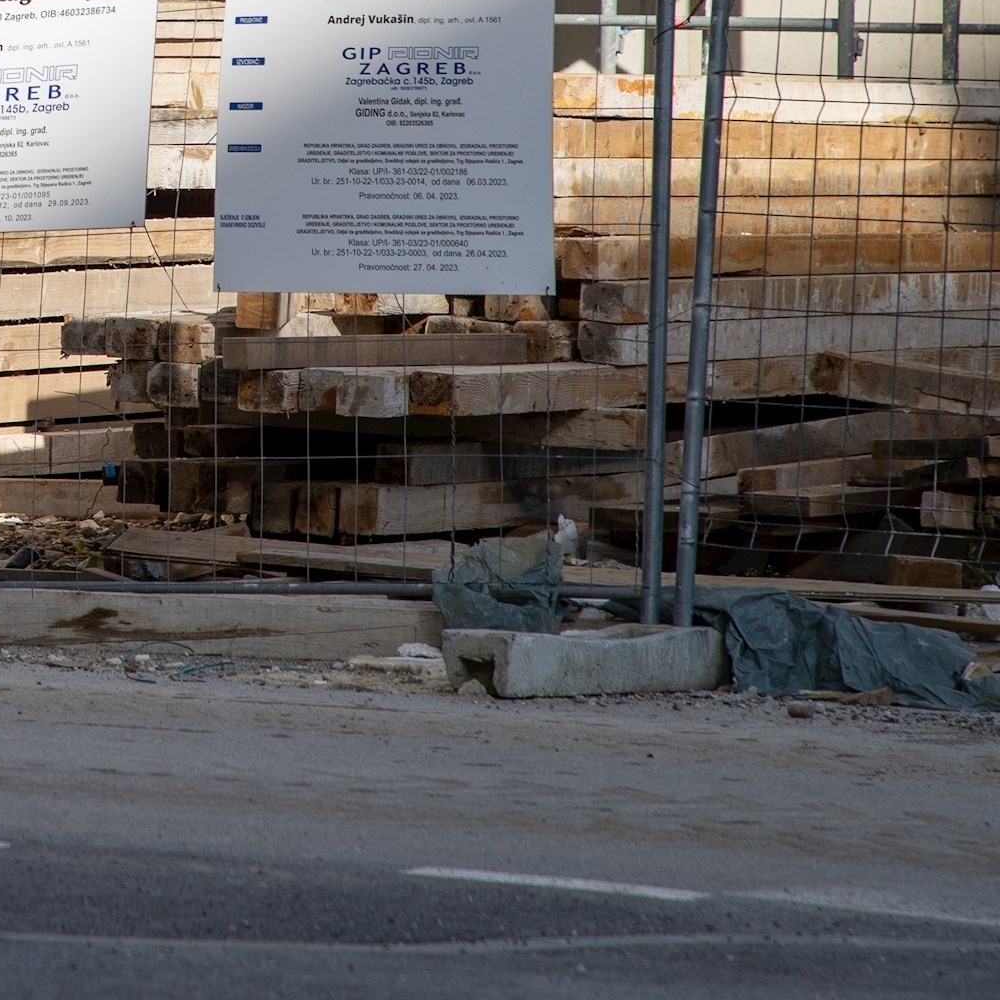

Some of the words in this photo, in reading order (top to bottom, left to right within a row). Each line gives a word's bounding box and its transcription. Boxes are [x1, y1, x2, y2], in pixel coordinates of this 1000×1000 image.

[4, 11, 37, 22] Zagreb,
[327, 14, 365, 27] Andrej
[342, 47, 381, 60] GIP
[359, 62, 466, 75] ZAGREB
[345, 76, 404, 87] Zagrebačka
[440, 76, 474, 87] Zagreb
[358, 97, 389, 105] Valentina
[32, 102, 70, 115] Zagreb
[355, 108, 386, 118] GIDING
[349, 167, 371, 175] Klasa:
[431, 178, 441, 186] od
[442, 178, 461, 186] dana
[466, 177, 509, 186] 06.03.2023.
[413, 192, 424, 200] 06.
[426, 192, 438, 200] 04.
[439, 192, 459, 201] 2023.
[13, 201, 23, 209] od
[24, 201, 42, 211] dana
